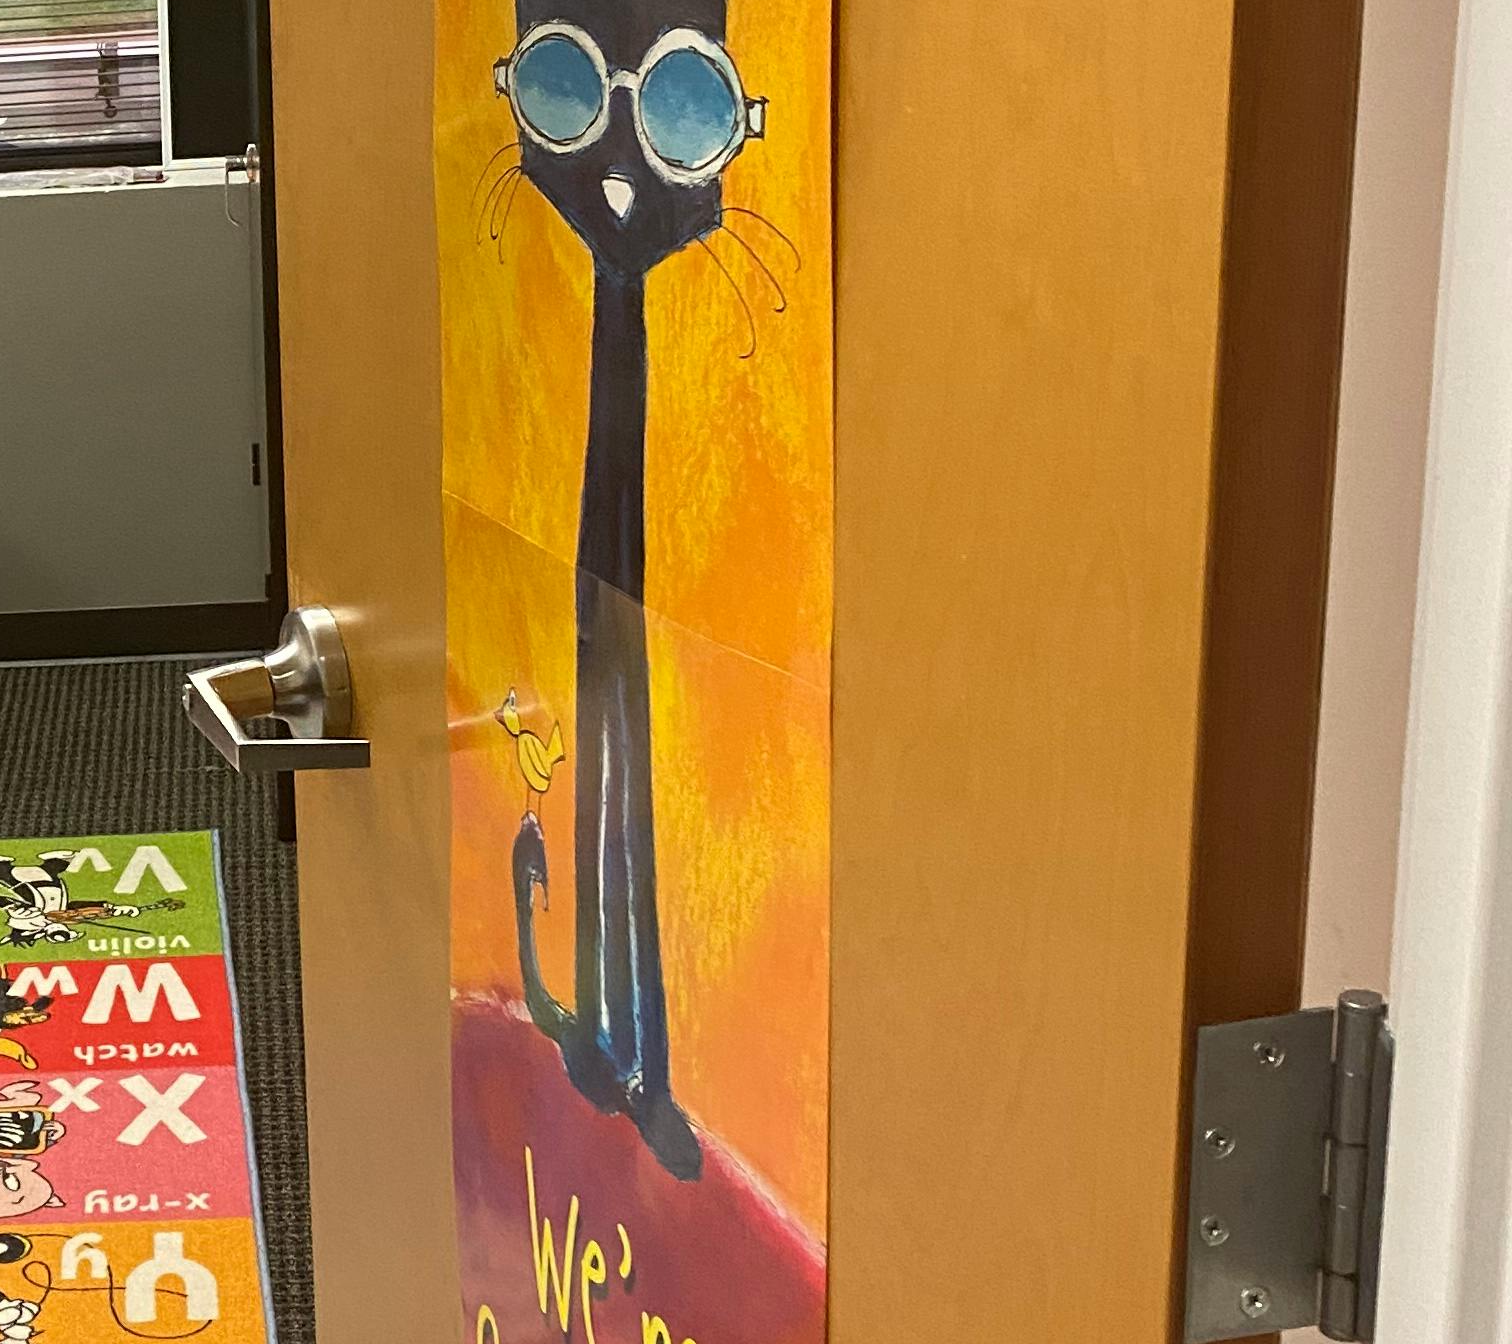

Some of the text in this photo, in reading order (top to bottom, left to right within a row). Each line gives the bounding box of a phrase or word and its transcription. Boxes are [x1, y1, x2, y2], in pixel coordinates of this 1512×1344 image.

[65, 845, 188, 894] Vv
[88, 933, 191, 956] violin
[6, 962, 201, 1023] Ww
[74, 1041, 199, 1064] watch
[45, 1073, 207, 1146] Xx
[84, 1190, 210, 1213] x-ray
[61, 1231, 218, 1322] Yy
